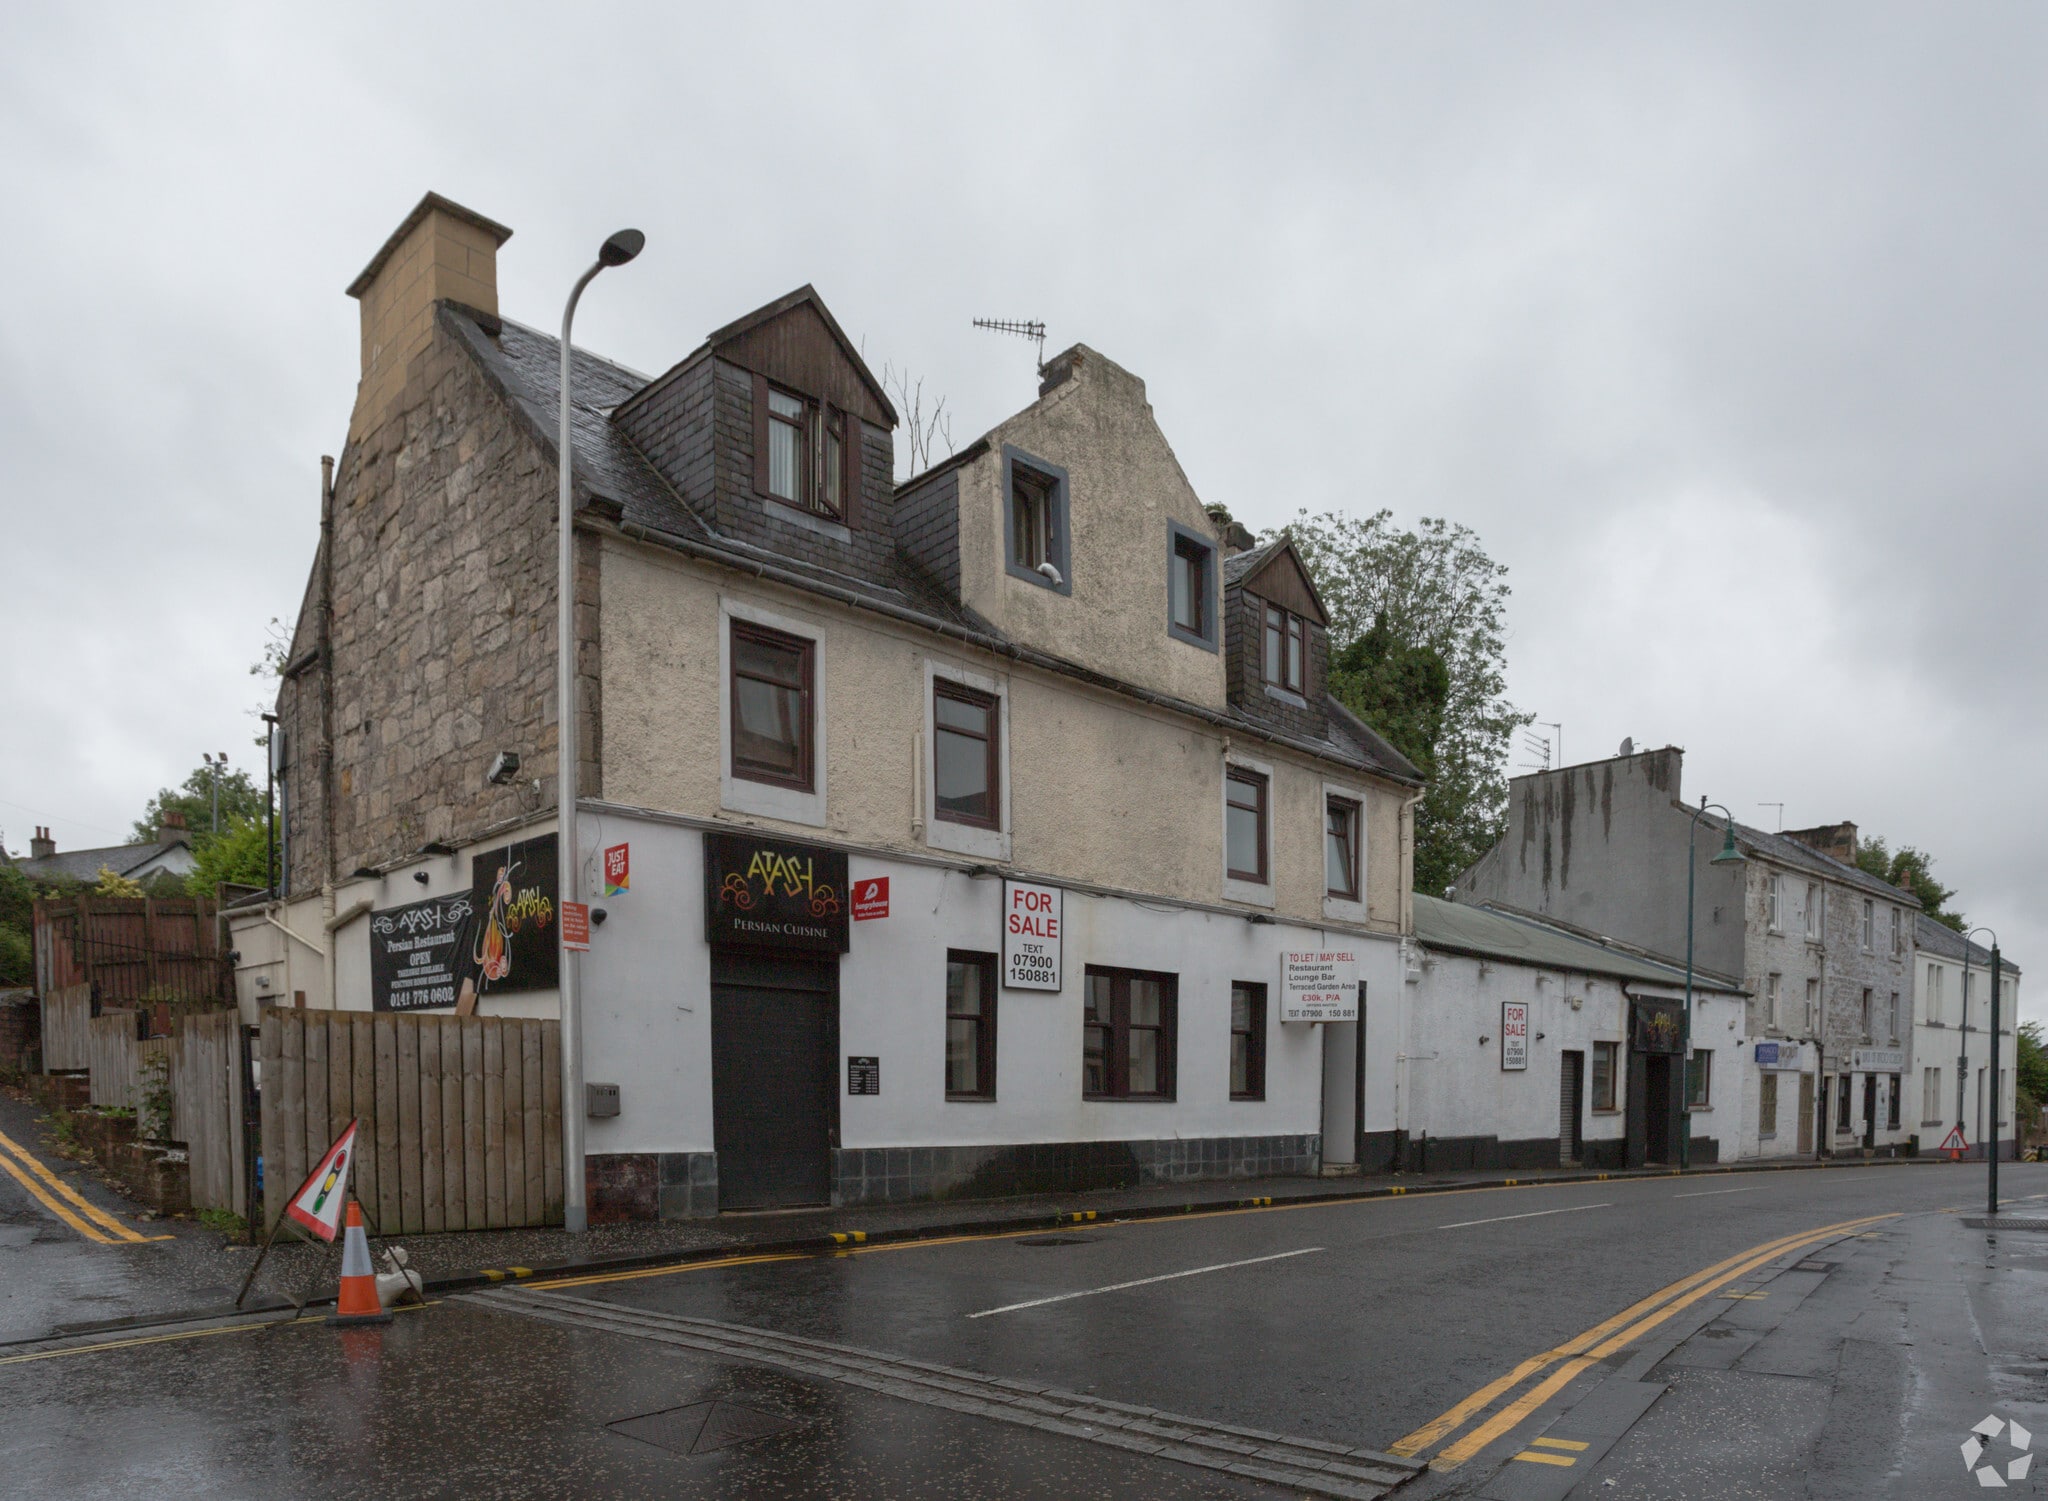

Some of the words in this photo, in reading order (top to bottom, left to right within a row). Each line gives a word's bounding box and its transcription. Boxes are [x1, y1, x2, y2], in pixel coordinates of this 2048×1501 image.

[608, 849, 625, 867] JUST
[611, 862, 625, 876] EAT
[747, 851, 813, 900] ATASH
[517, 886, 540, 919] ATASH
[1013, 889, 1052, 913] FOR
[399, 905, 441, 933] ATASH
[1009, 914, 1058, 938] SALE
[734, 918, 780, 933] PERSIAN
[783, 923, 829, 938] CUISINE
[387, 939, 413, 953] Persian
[414, 929, 455, 949] Restaurant
[1023, 944, 1044, 954] TEXT
[409, 951, 431, 966] OPEN
[1013, 954, 1053, 969] 07900
[1289, 953, 1299, 962] TO
[1301, 953, 1314, 962] LET
[1320, 953, 1335, 962] MAY
[1337, 953, 1355, 962] SELL
[1010, 968, 1056, 983] 150881
[1289, 974, 1319, 982] Lounge
[390, 991, 410, 1007] 0141
[413, 989, 428, 1004] 776
[430, 986, 454, 1003] 0602
[1288, 1009, 1300, 1017] TEXT
[1507, 1008, 1524, 1020] FOR
[1505, 1024, 1526, 1036] SALE
